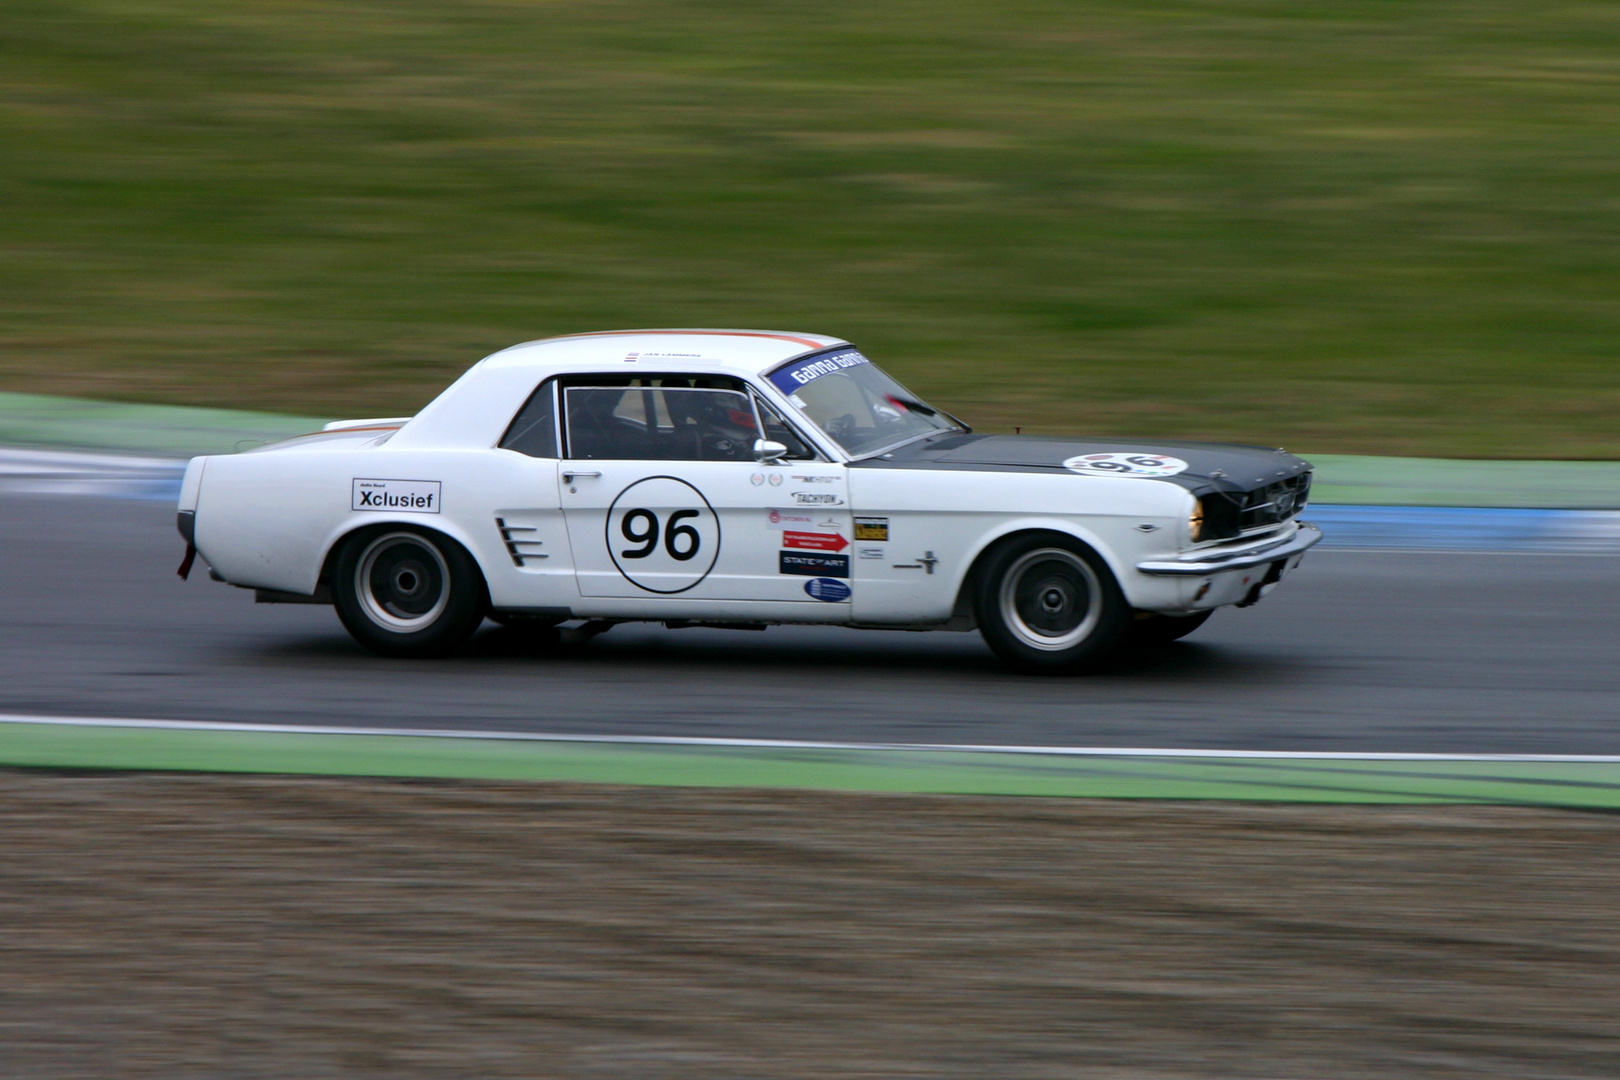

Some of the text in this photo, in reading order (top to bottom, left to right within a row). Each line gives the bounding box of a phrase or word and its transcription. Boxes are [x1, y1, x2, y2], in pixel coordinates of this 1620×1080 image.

[1089, 456, 1164, 473] 96
[360, 491, 433, 508] Xclusief
[797, 494, 837, 503] TACHYON
[621, 508, 700, 561] 96
[783, 556, 816, 566] STATE
